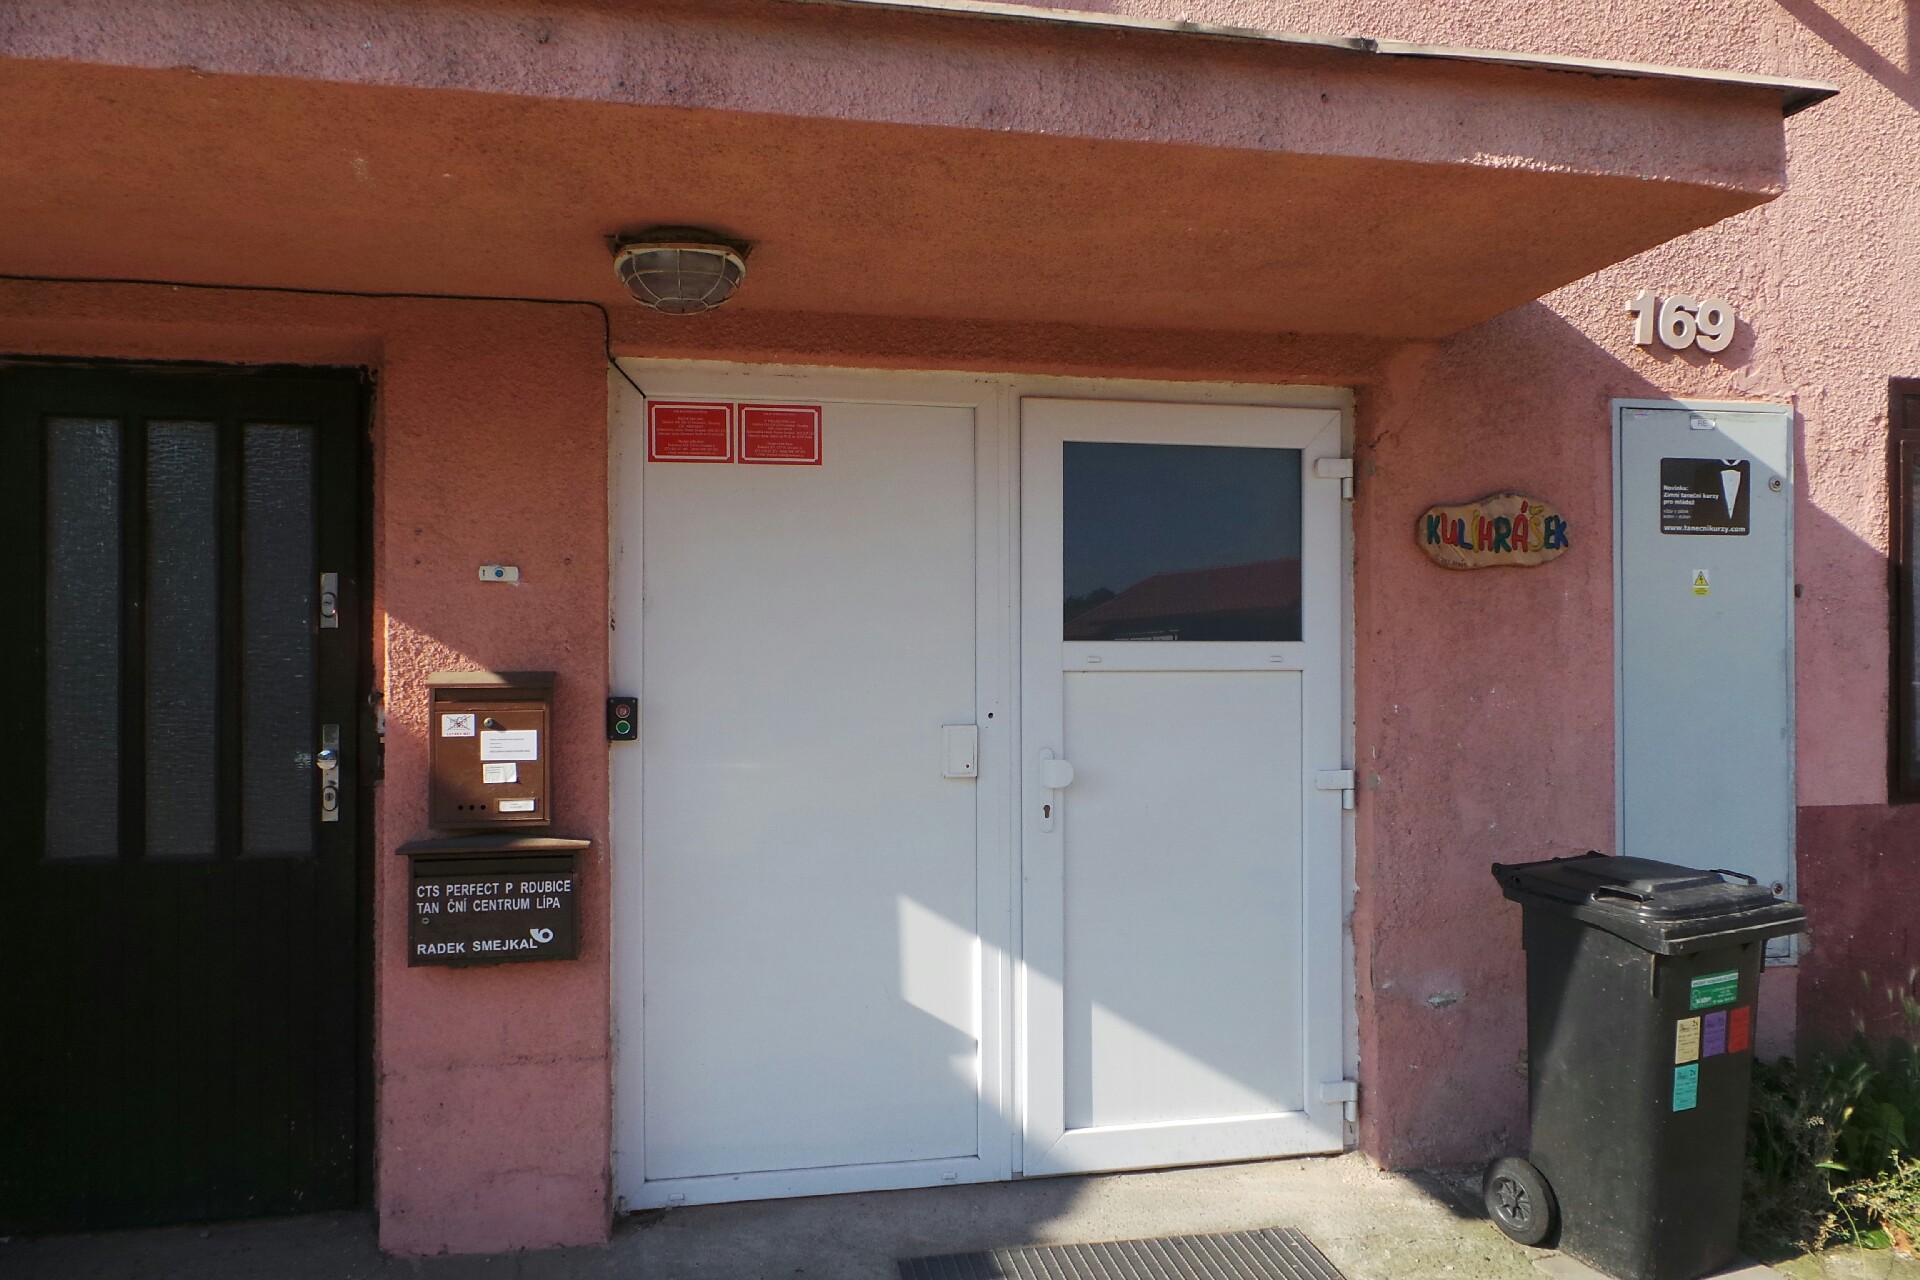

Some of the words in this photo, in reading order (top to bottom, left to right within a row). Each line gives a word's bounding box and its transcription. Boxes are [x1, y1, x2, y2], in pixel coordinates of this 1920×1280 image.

[1625, 290, 1735, 352] 169
[1702, 492, 1719, 500] kurzy
[416, 885, 440, 898] CTS
[446, 883, 500, 896] PERFECT
[472, 898, 530, 912] CENTRUM
[536, 895, 561, 909] LÍPA
[417, 943, 466, 955] RADEK
[472, 938, 538, 952] SMEJKAL
